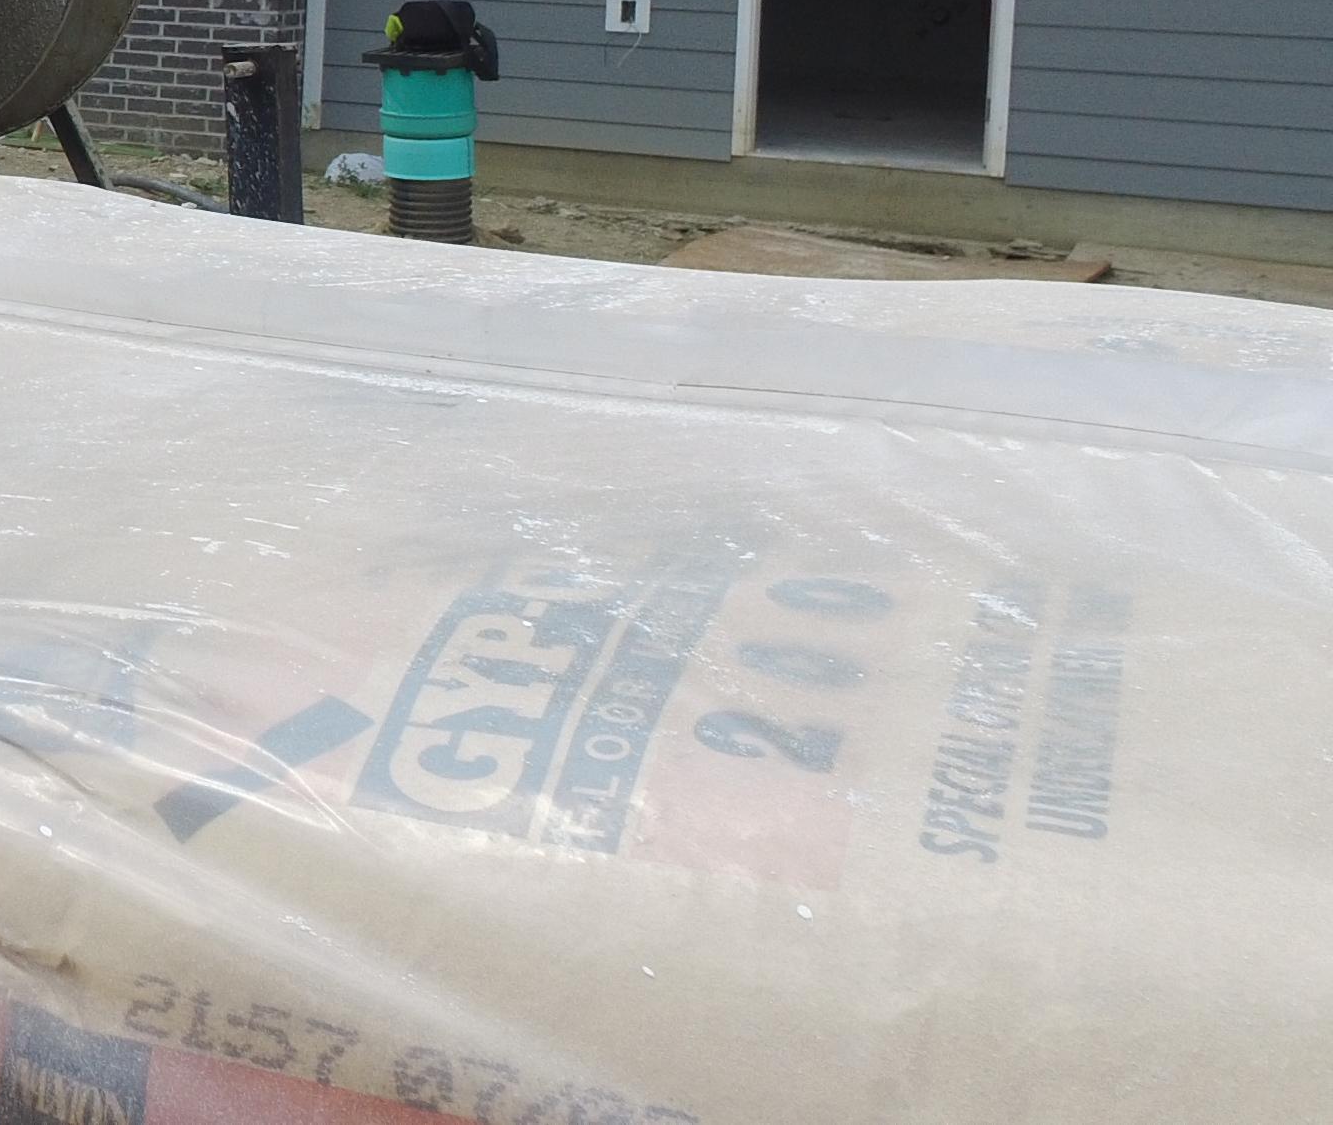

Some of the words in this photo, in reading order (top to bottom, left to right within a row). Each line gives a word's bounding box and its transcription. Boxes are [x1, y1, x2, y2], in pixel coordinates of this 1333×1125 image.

[693, 576, 896, 773] 200
[565, 675, 658, 842] FLOOR
[919, 733, 1016, 863] SPECIAL
